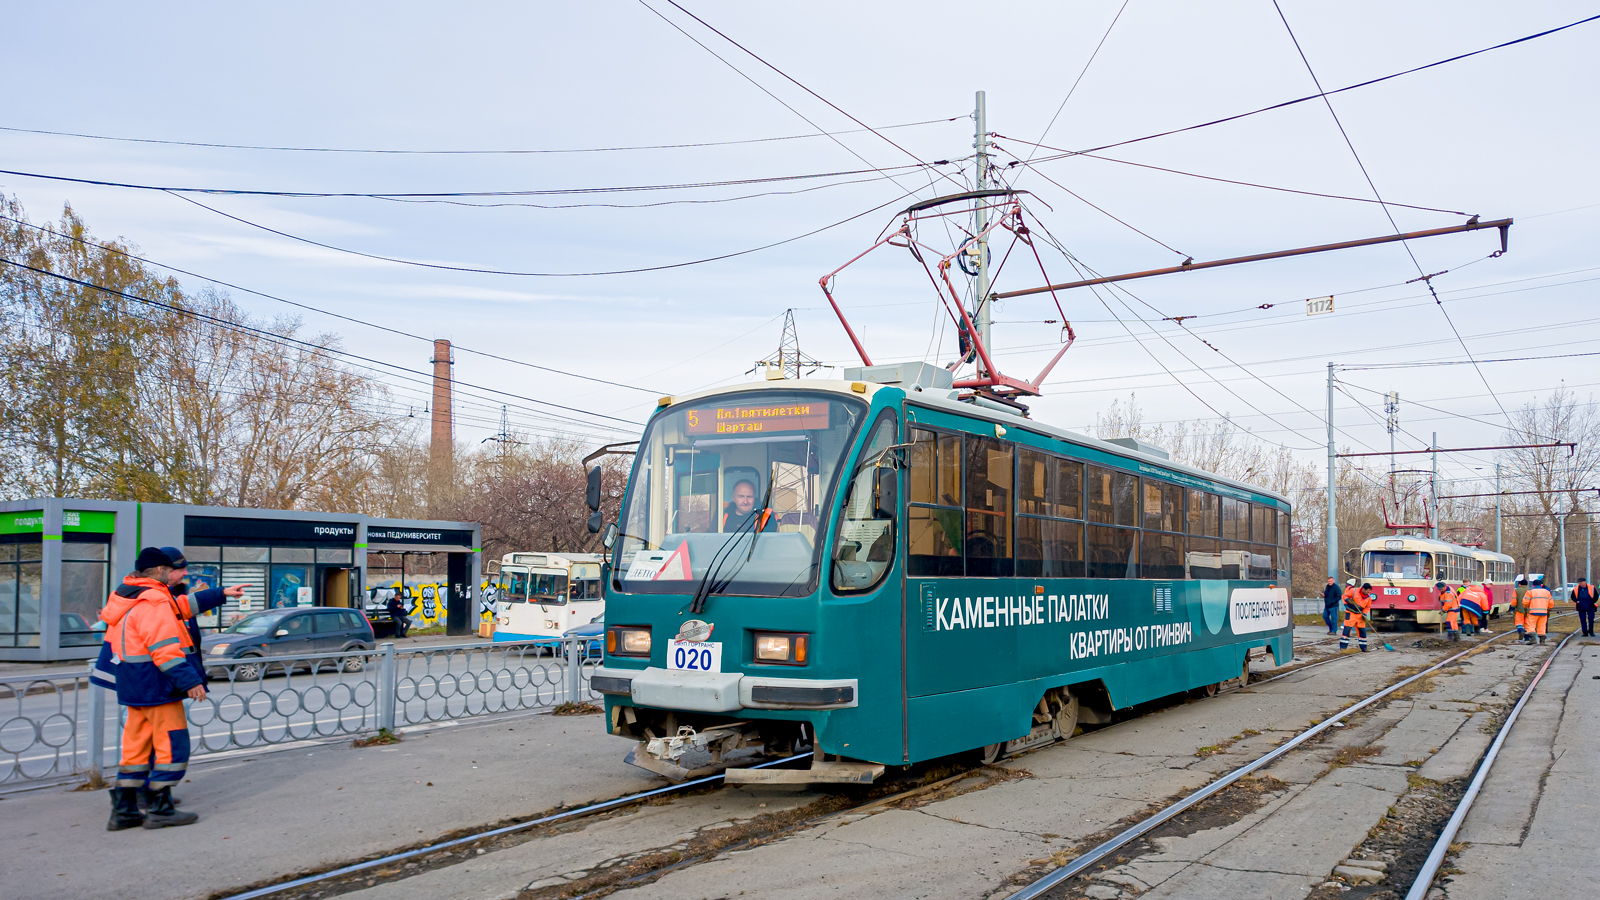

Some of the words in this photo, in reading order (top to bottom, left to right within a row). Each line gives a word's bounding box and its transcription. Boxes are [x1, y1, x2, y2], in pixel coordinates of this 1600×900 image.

[1307, 299, 1333, 313] 1172
[688, 410, 699, 428] 5
[716, 422, 763, 433] Шарташ
[314, 526, 354, 536] продукты
[387, 531, 441, 540] ПЕДУНИВЕРСИТЕТ
[630, 569, 658, 578] ДЕПО
[936, 595, 1045, 631] КАМЕННЫЕ
[1048, 594, 1108, 623] ПАЛАТКИ
[1235, 601, 1269, 621] ПОСЛЕДНЯЯ
[1070, 627, 1132, 660] КВАРТИРЫ
[1135, 625, 1149, 650] ОТ
[1150, 621, 1192, 648] ГРИНВИЧ
[675, 647, 712, 671] 020
